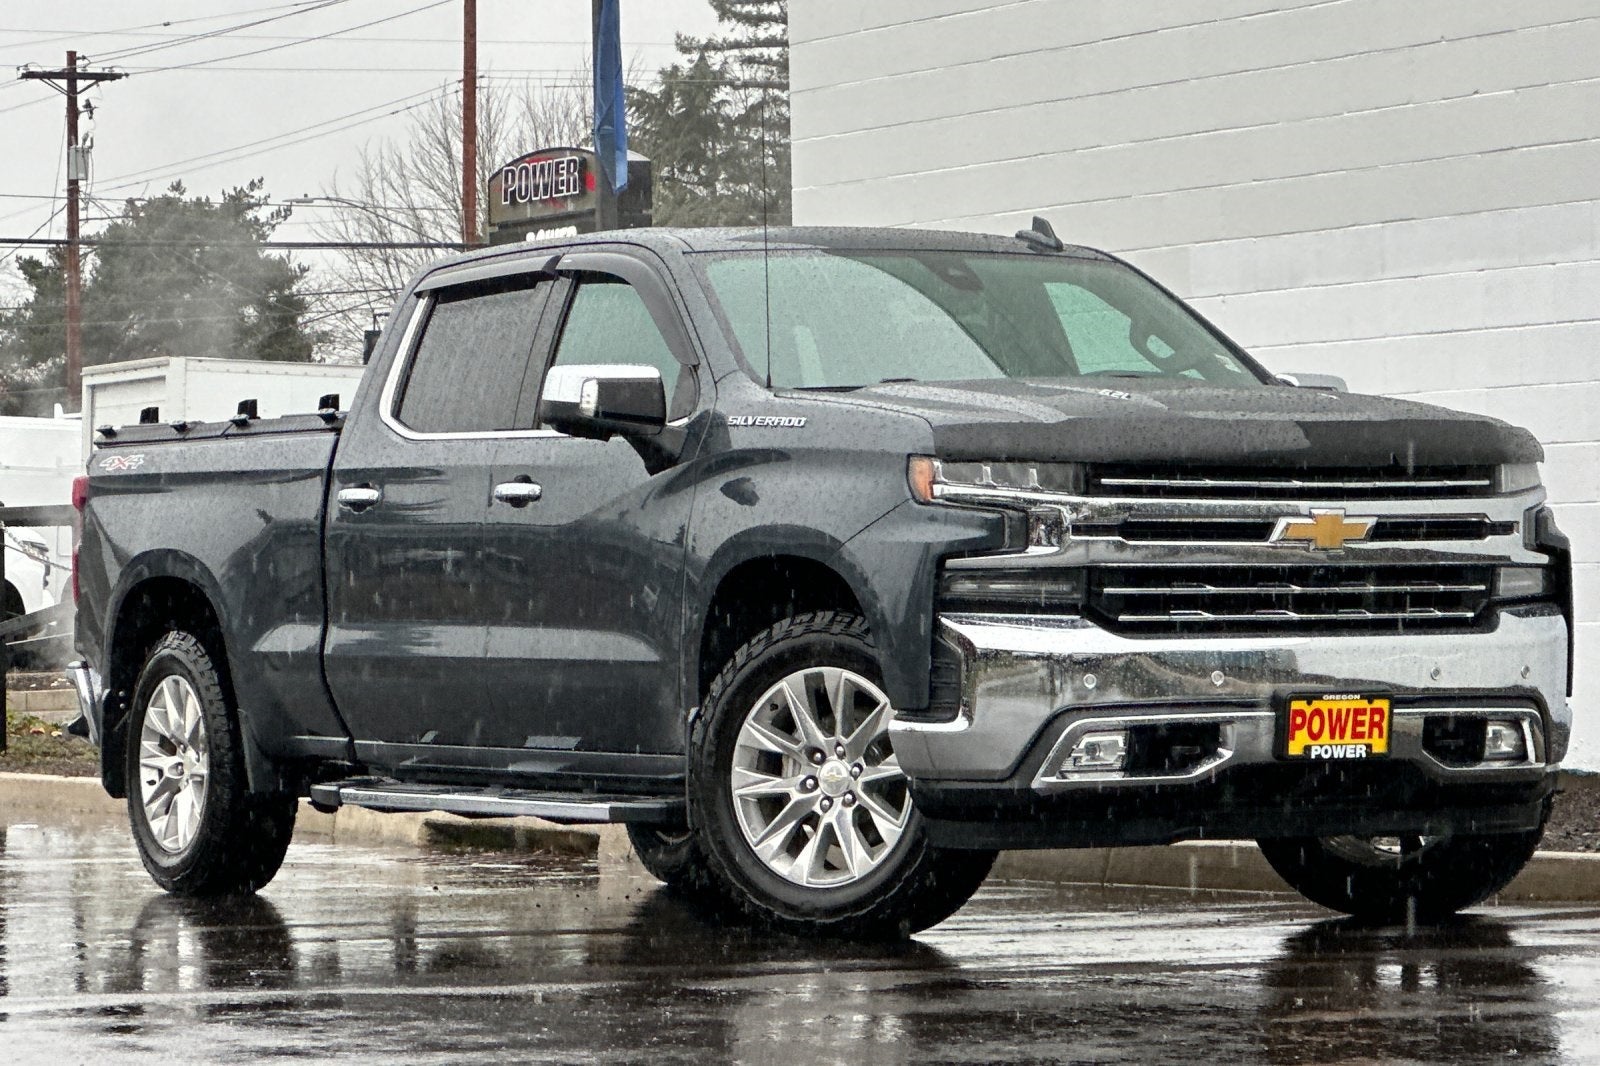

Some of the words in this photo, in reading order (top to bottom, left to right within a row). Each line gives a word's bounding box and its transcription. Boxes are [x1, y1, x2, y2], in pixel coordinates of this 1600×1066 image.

[502, 157, 579, 204] POWER
[728, 416, 807, 427] SILVERADO
[1289, 707, 1385, 742] POWER
[1311, 744, 1367, 759] POWER
